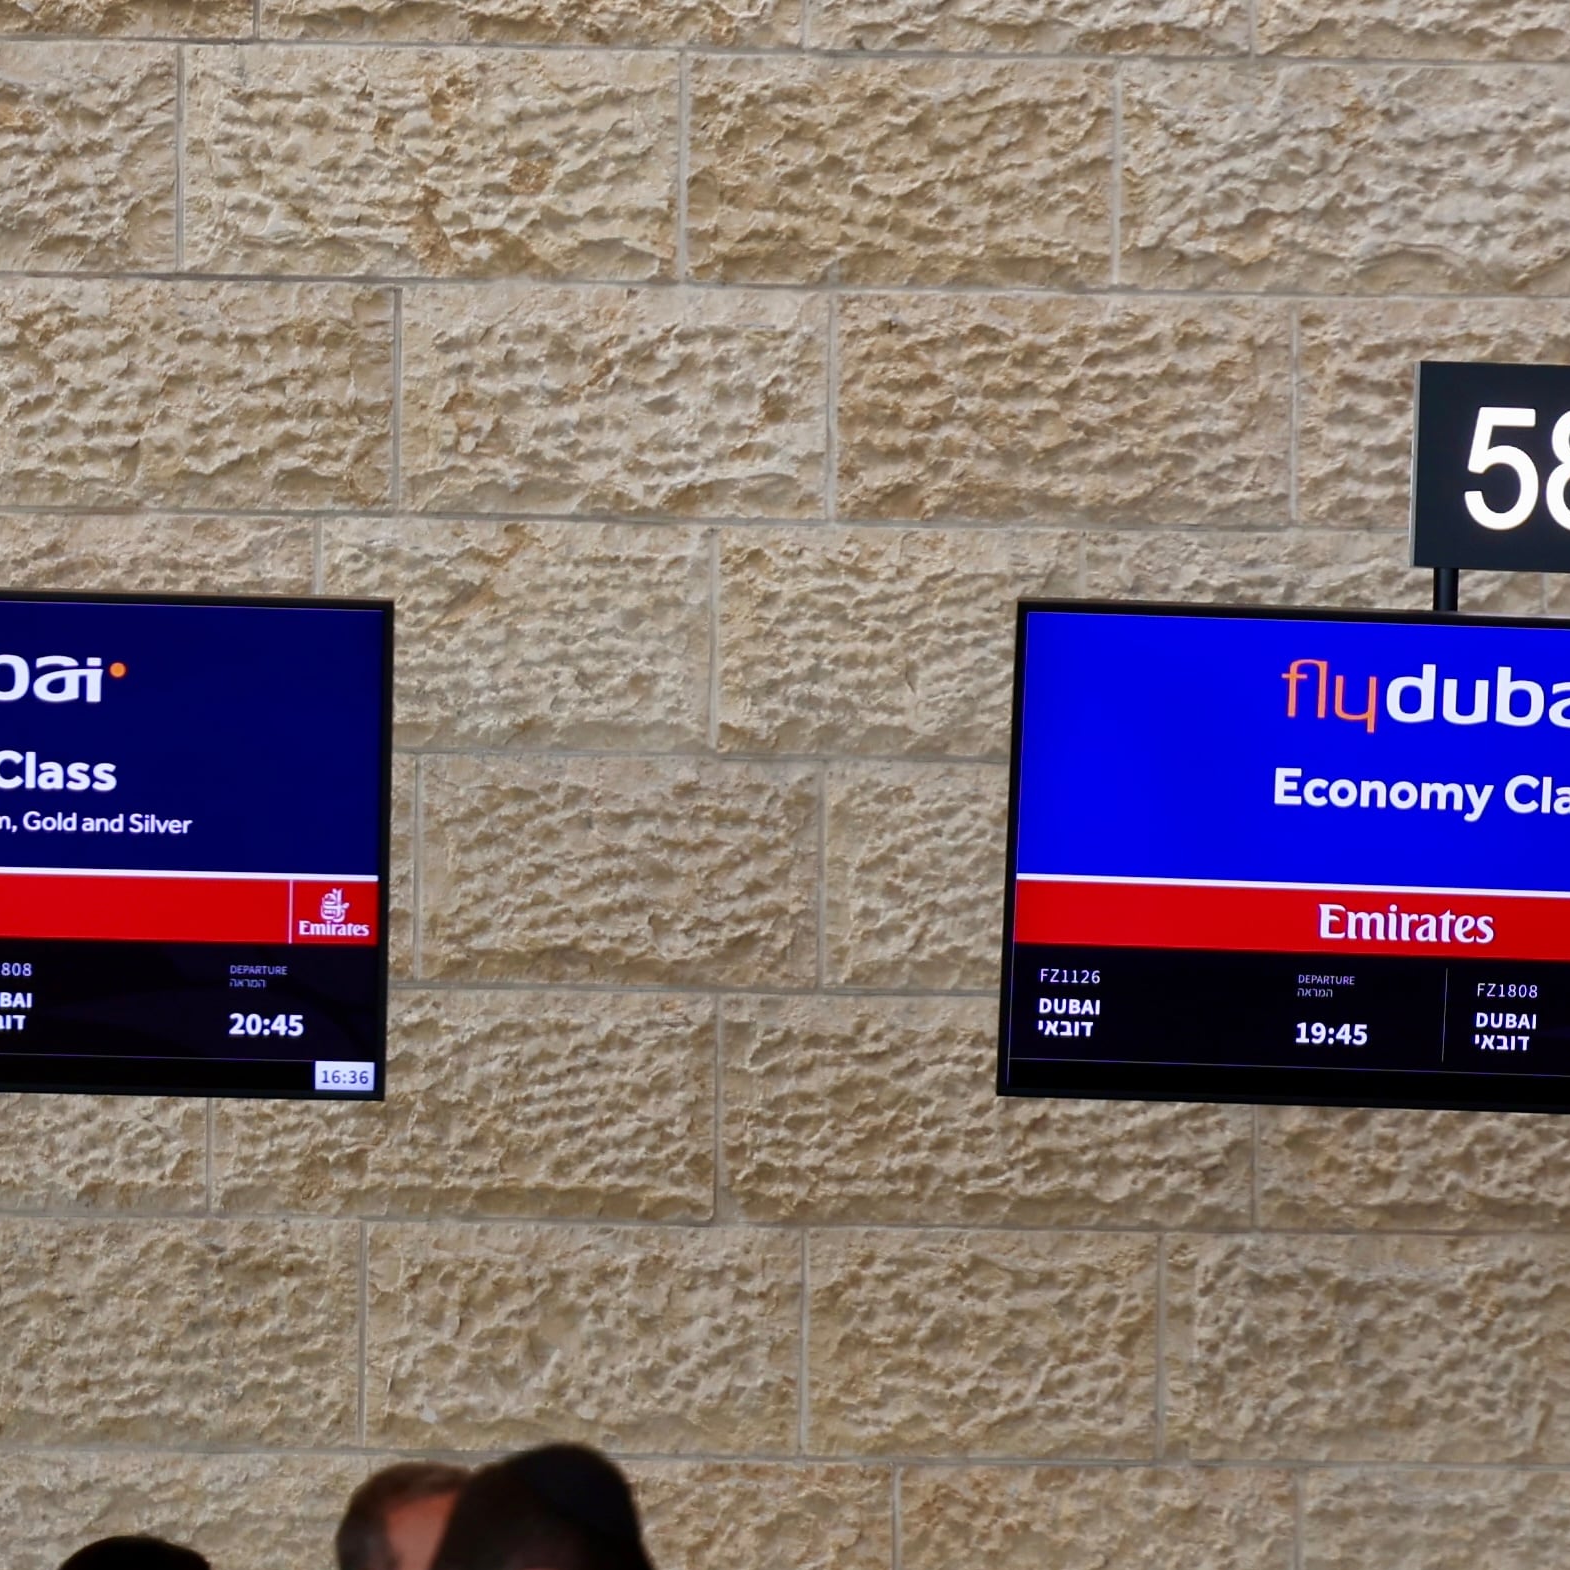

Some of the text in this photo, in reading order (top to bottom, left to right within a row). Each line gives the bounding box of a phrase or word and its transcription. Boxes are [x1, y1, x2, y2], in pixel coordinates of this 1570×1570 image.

[1274, 768, 1494, 822] Economy
[23, 811, 77, 831] Gold
[82, 814, 123, 832] and
[129, 813, 192, 834] Silver
[299, 921, 369, 936] Emirates
[1318, 904, 1495, 943] Emirates
[230, 965, 287, 975] DEPARTURE
[1041, 969, 1100, 984] FZ1126
[1299, 975, 1354, 984] DEPARTURE
[1478, 983, 1537, 998] FZ1808
[1039, 998, 1100, 1015] DUBAI
[229, 1013, 304, 1036] 20:45
[1038, 1020, 1093, 1037] דובאי
[1476, 1012, 1536, 1029] DUBAI
[1296, 1022, 1367, 1045] 19:45
[1475, 1034, 1529, 1051] דובאי
[322, 1071, 368, 1084] 16:36
